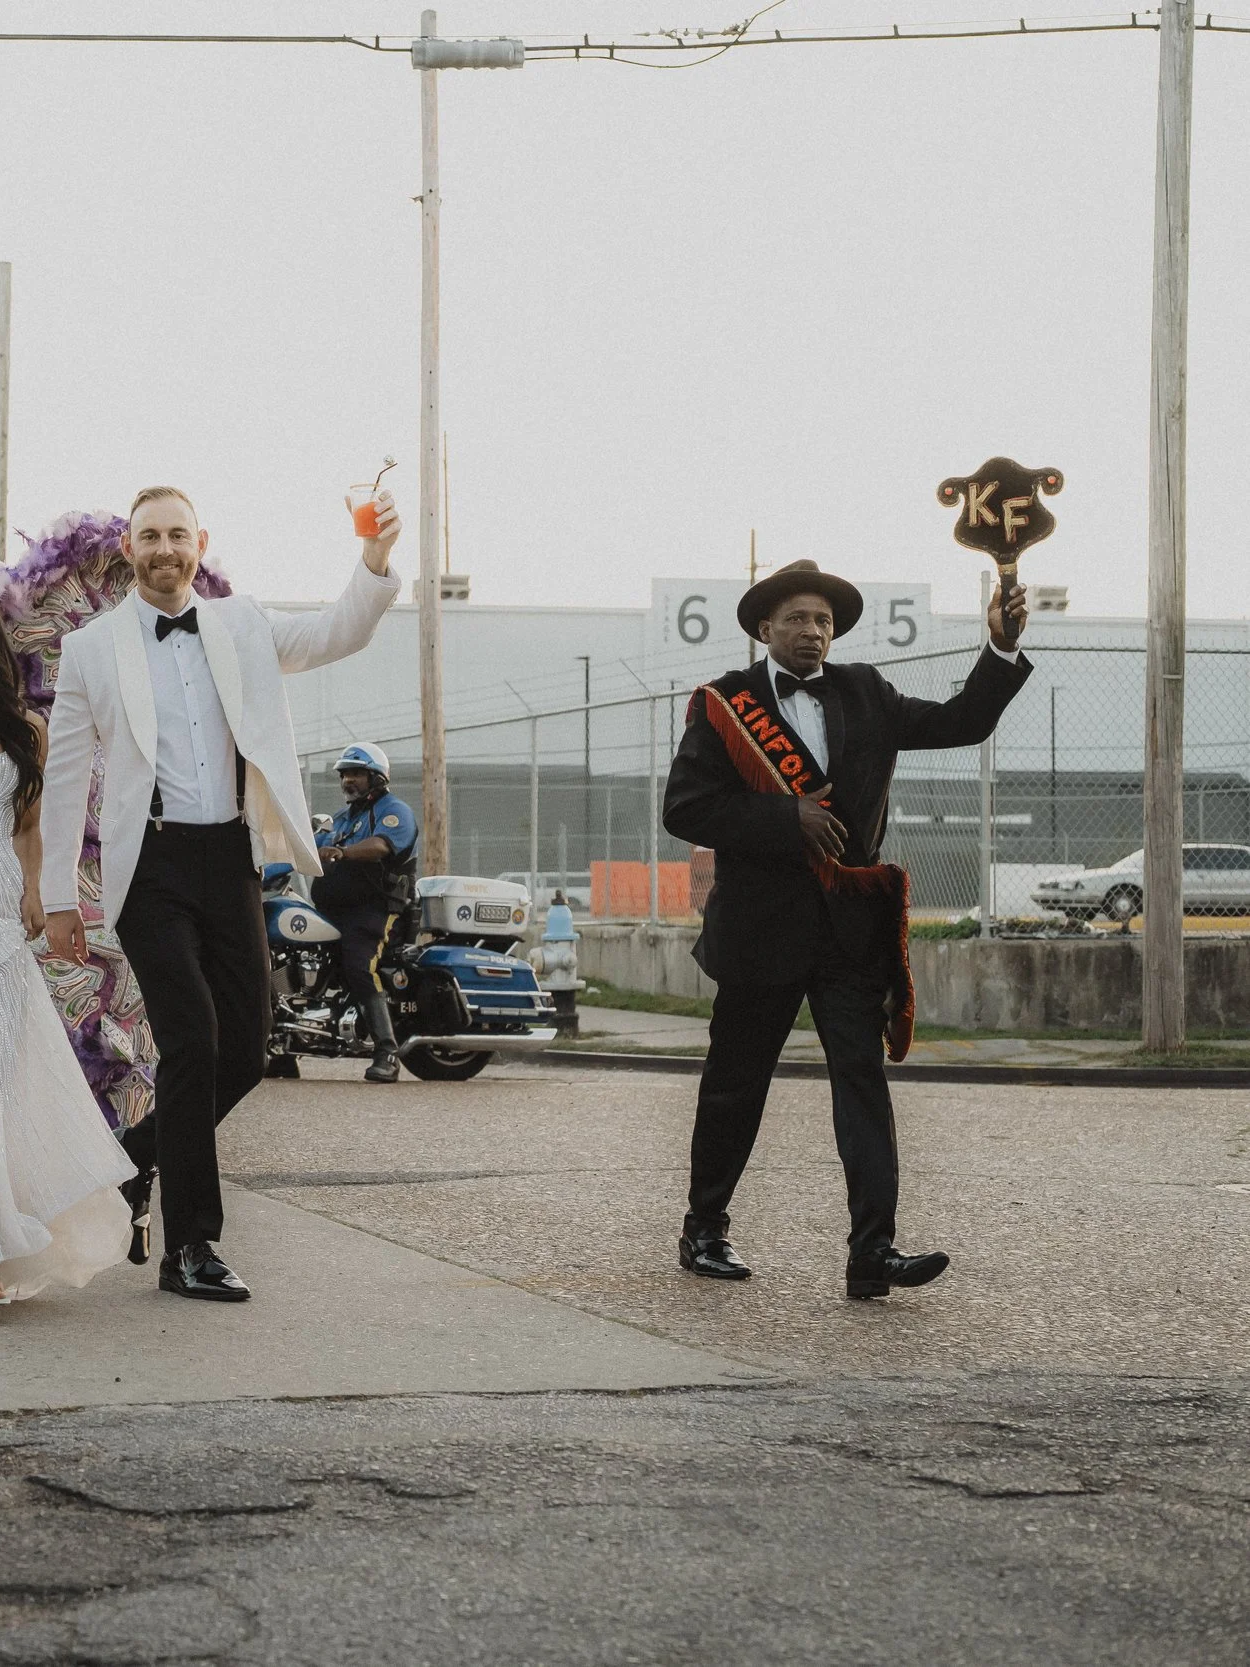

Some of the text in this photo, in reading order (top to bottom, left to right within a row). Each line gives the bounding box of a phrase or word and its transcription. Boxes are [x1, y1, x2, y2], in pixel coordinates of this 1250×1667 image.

[968, 480, 1034, 544] KF
[677, 595, 710, 644] 6
[887, 599, 917, 647] 5
[731, 690, 831, 807] KINFOL
